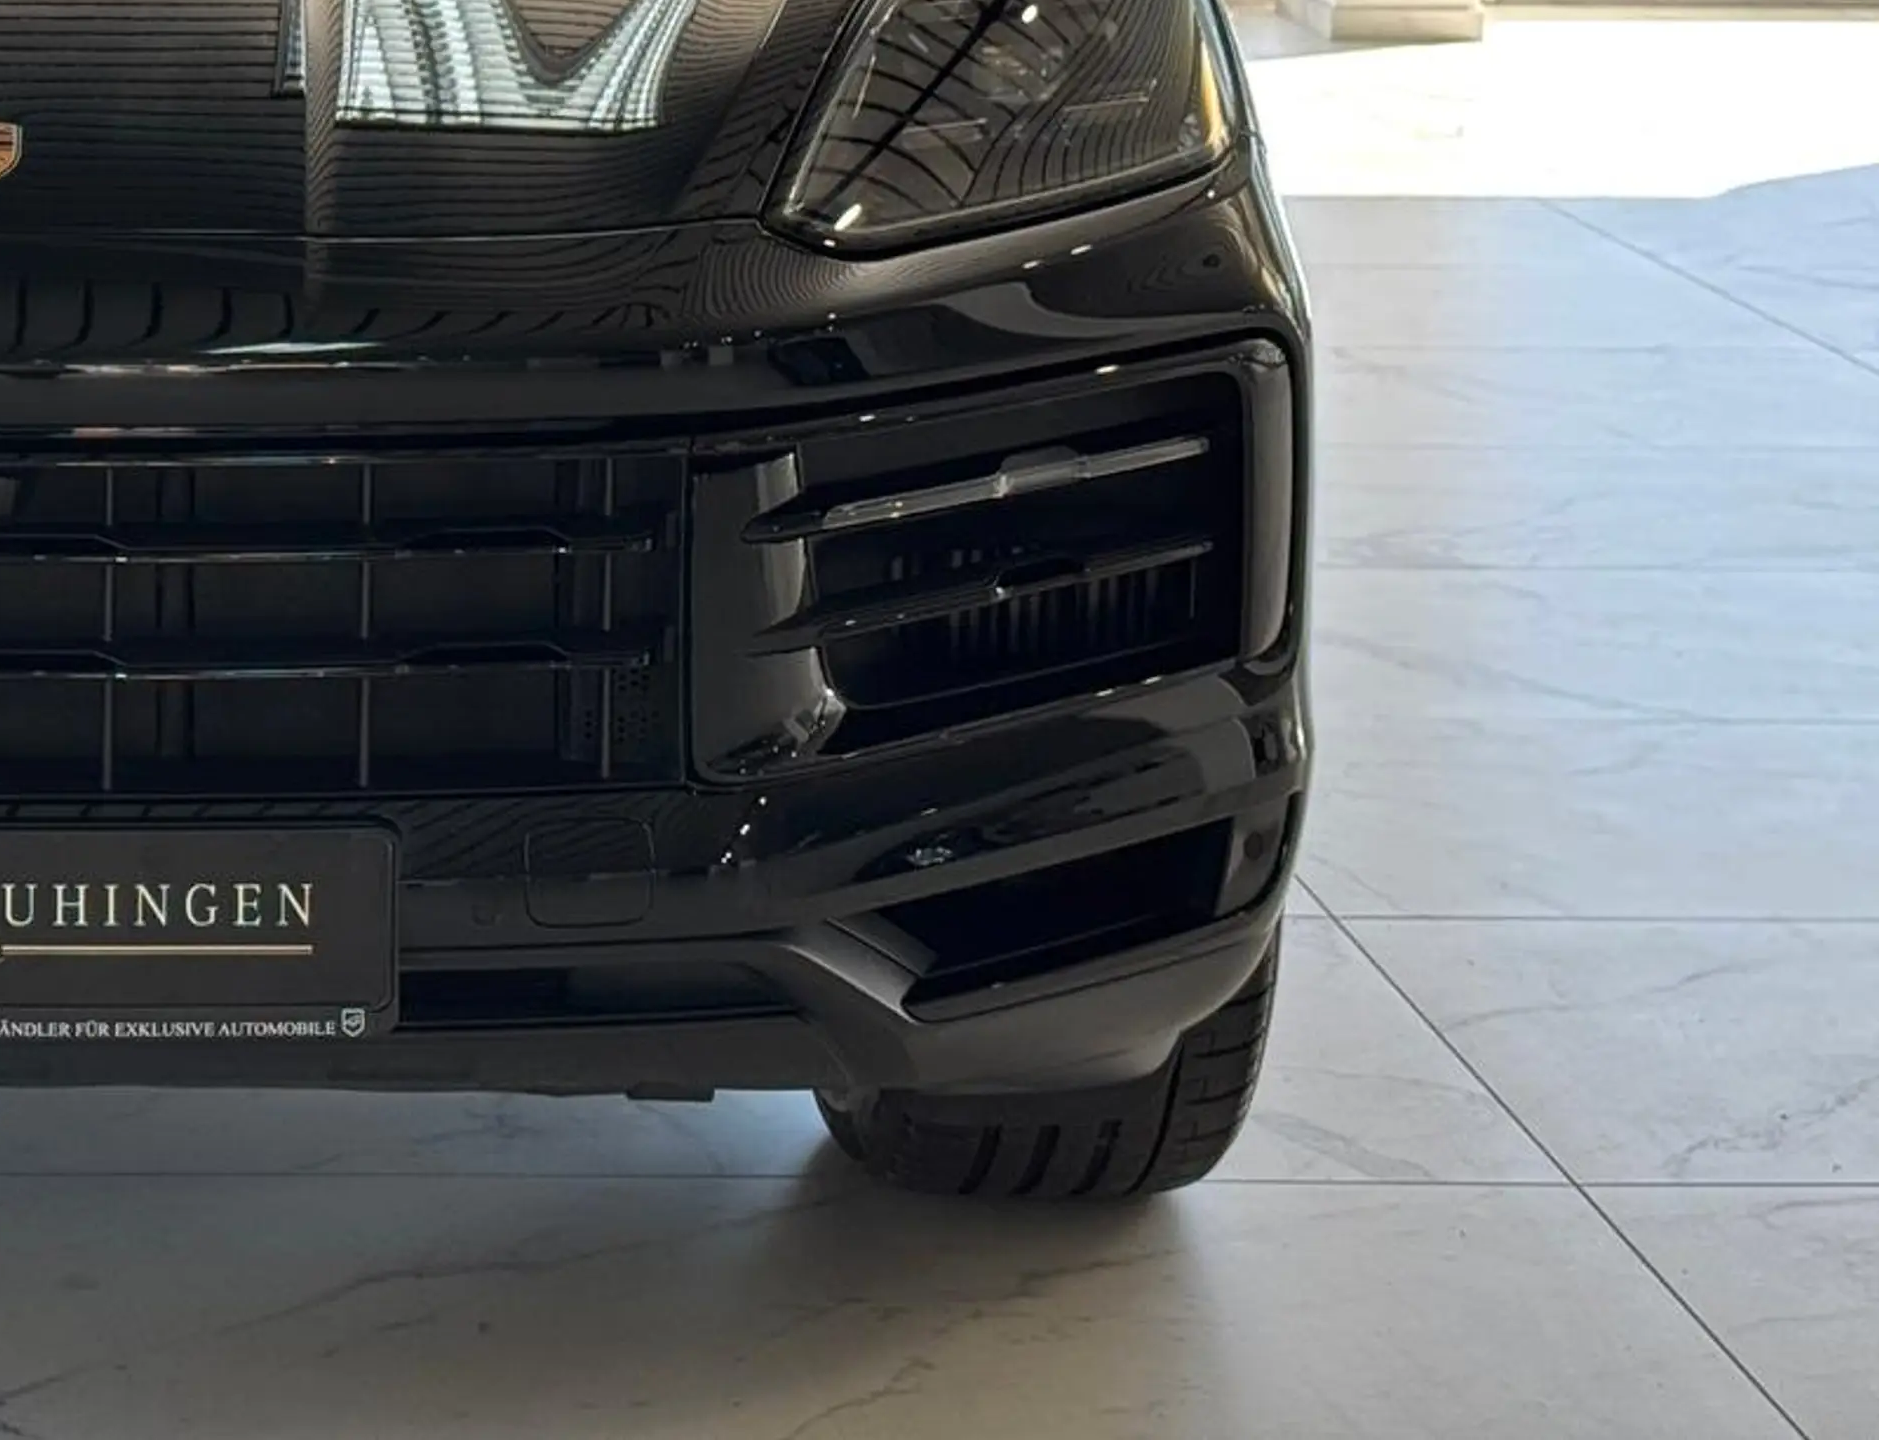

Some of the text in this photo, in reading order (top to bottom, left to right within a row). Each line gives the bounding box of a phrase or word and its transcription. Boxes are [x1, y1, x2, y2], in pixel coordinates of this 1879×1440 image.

[1, 882, 314, 928] UHINGEN
[74, 1018, 110, 1038] FÜR
[114, 1020, 215, 1038] EXKLUSIVE
[219, 1019, 337, 1037] AUTOMOBILE
